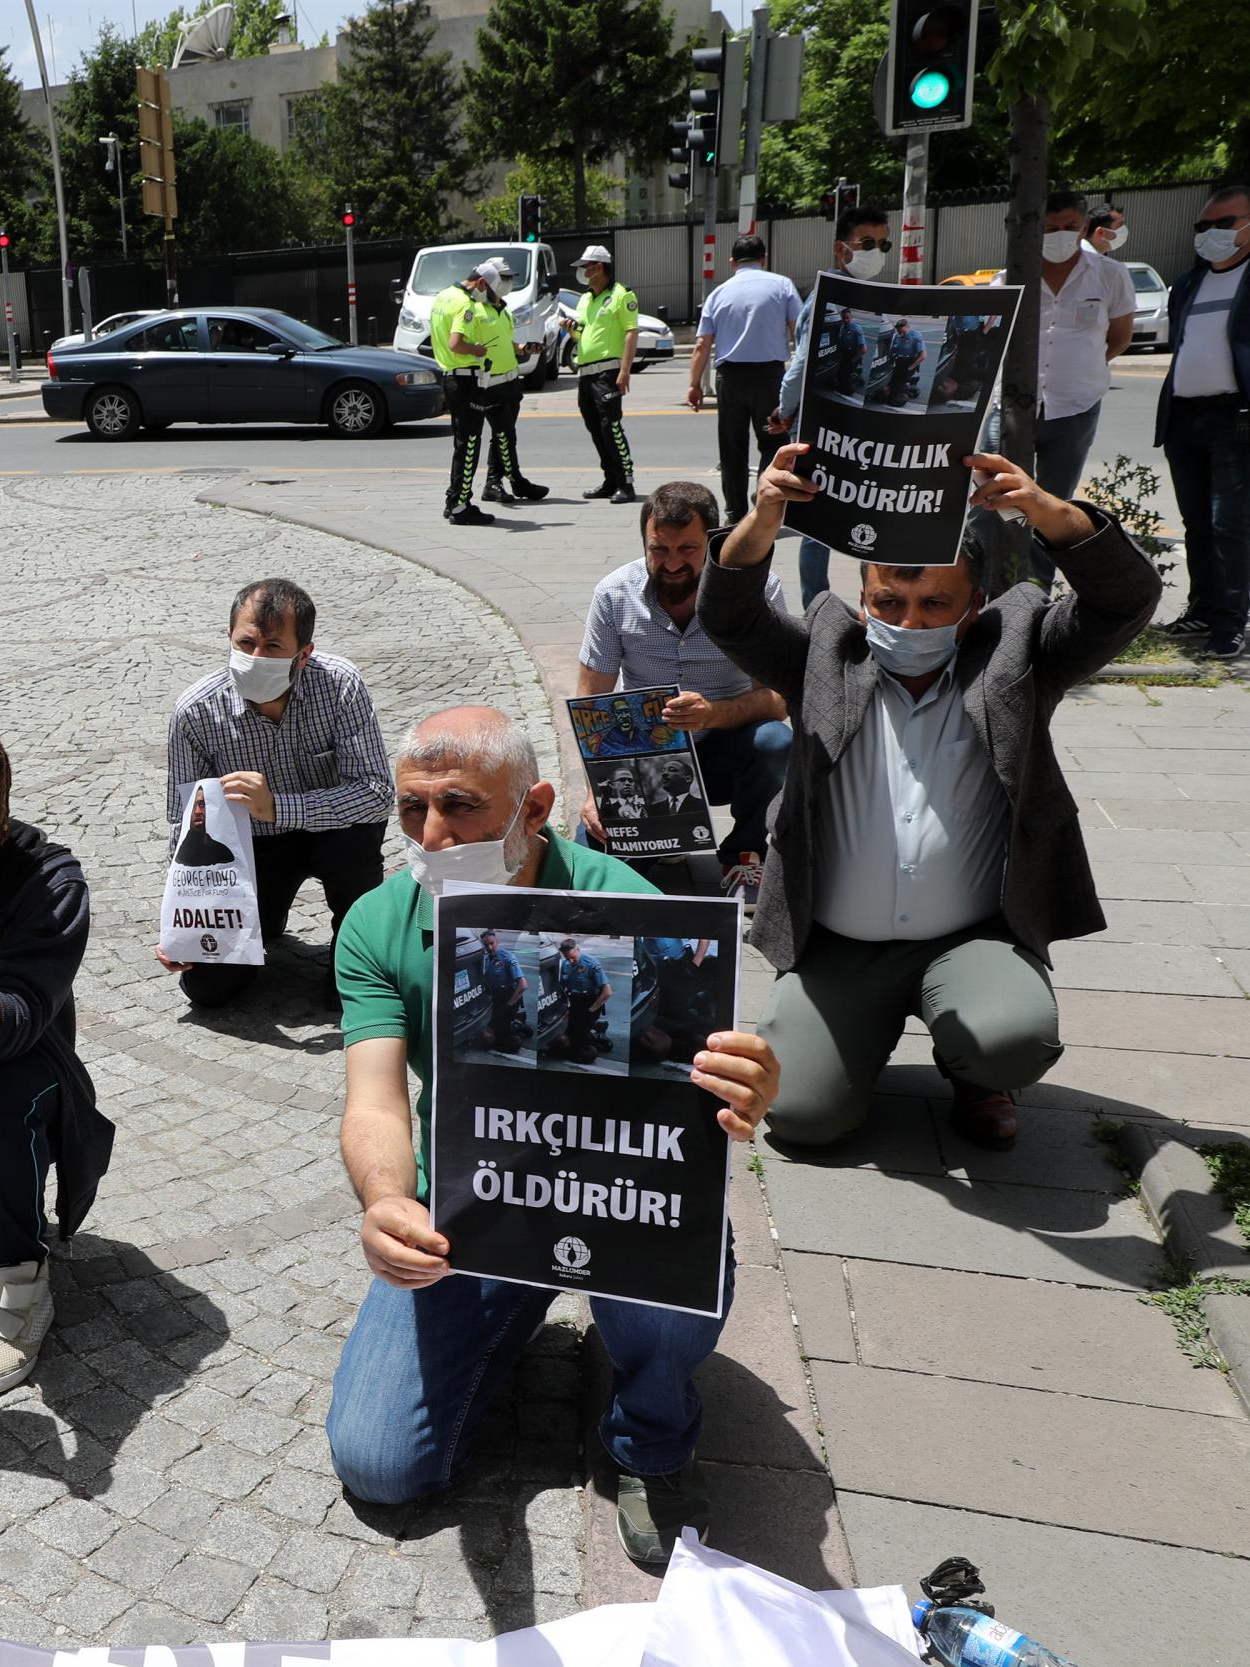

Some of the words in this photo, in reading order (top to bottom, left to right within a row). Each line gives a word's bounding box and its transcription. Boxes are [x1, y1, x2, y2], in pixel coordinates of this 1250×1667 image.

[816, 427, 952, 470] IRKÇILILIK
[811, 464, 944, 514] ÖLDÜRÜR!
[606, 826, 639, 837] NEFES
[612, 838, 680, 852] ALAMIYORUZ
[173, 870, 205, 887] GEORGE
[206, 870, 236, 887] FLOYD
[173, 908, 243, 929] ADALET!
[474, 1106, 686, 1162] IRKÇILILIK
[472, 1160, 682, 1228] ÖLDÜRÜR!
